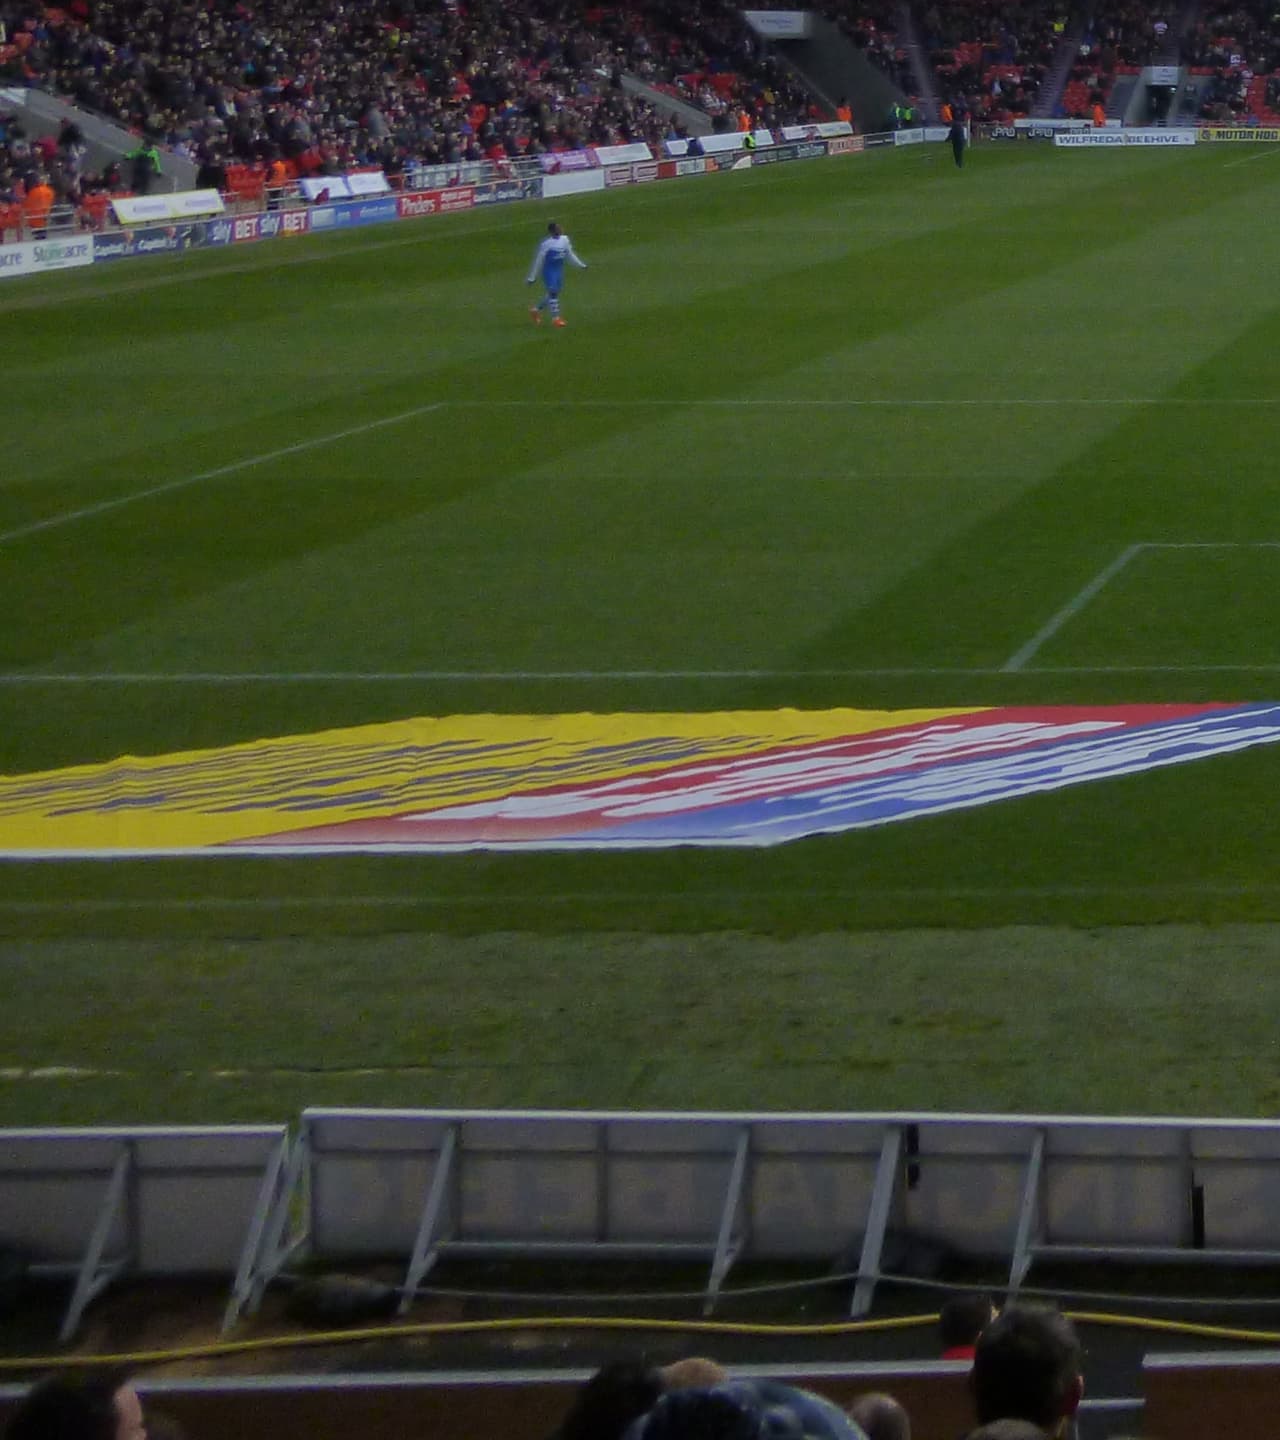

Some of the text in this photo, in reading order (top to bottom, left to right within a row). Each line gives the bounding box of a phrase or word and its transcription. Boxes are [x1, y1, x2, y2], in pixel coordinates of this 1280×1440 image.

[1058, 135, 1180, 144] WILFREDA BEEHIVE
[235, 218, 259, 240] BET
[284, 212, 308, 232] BET
